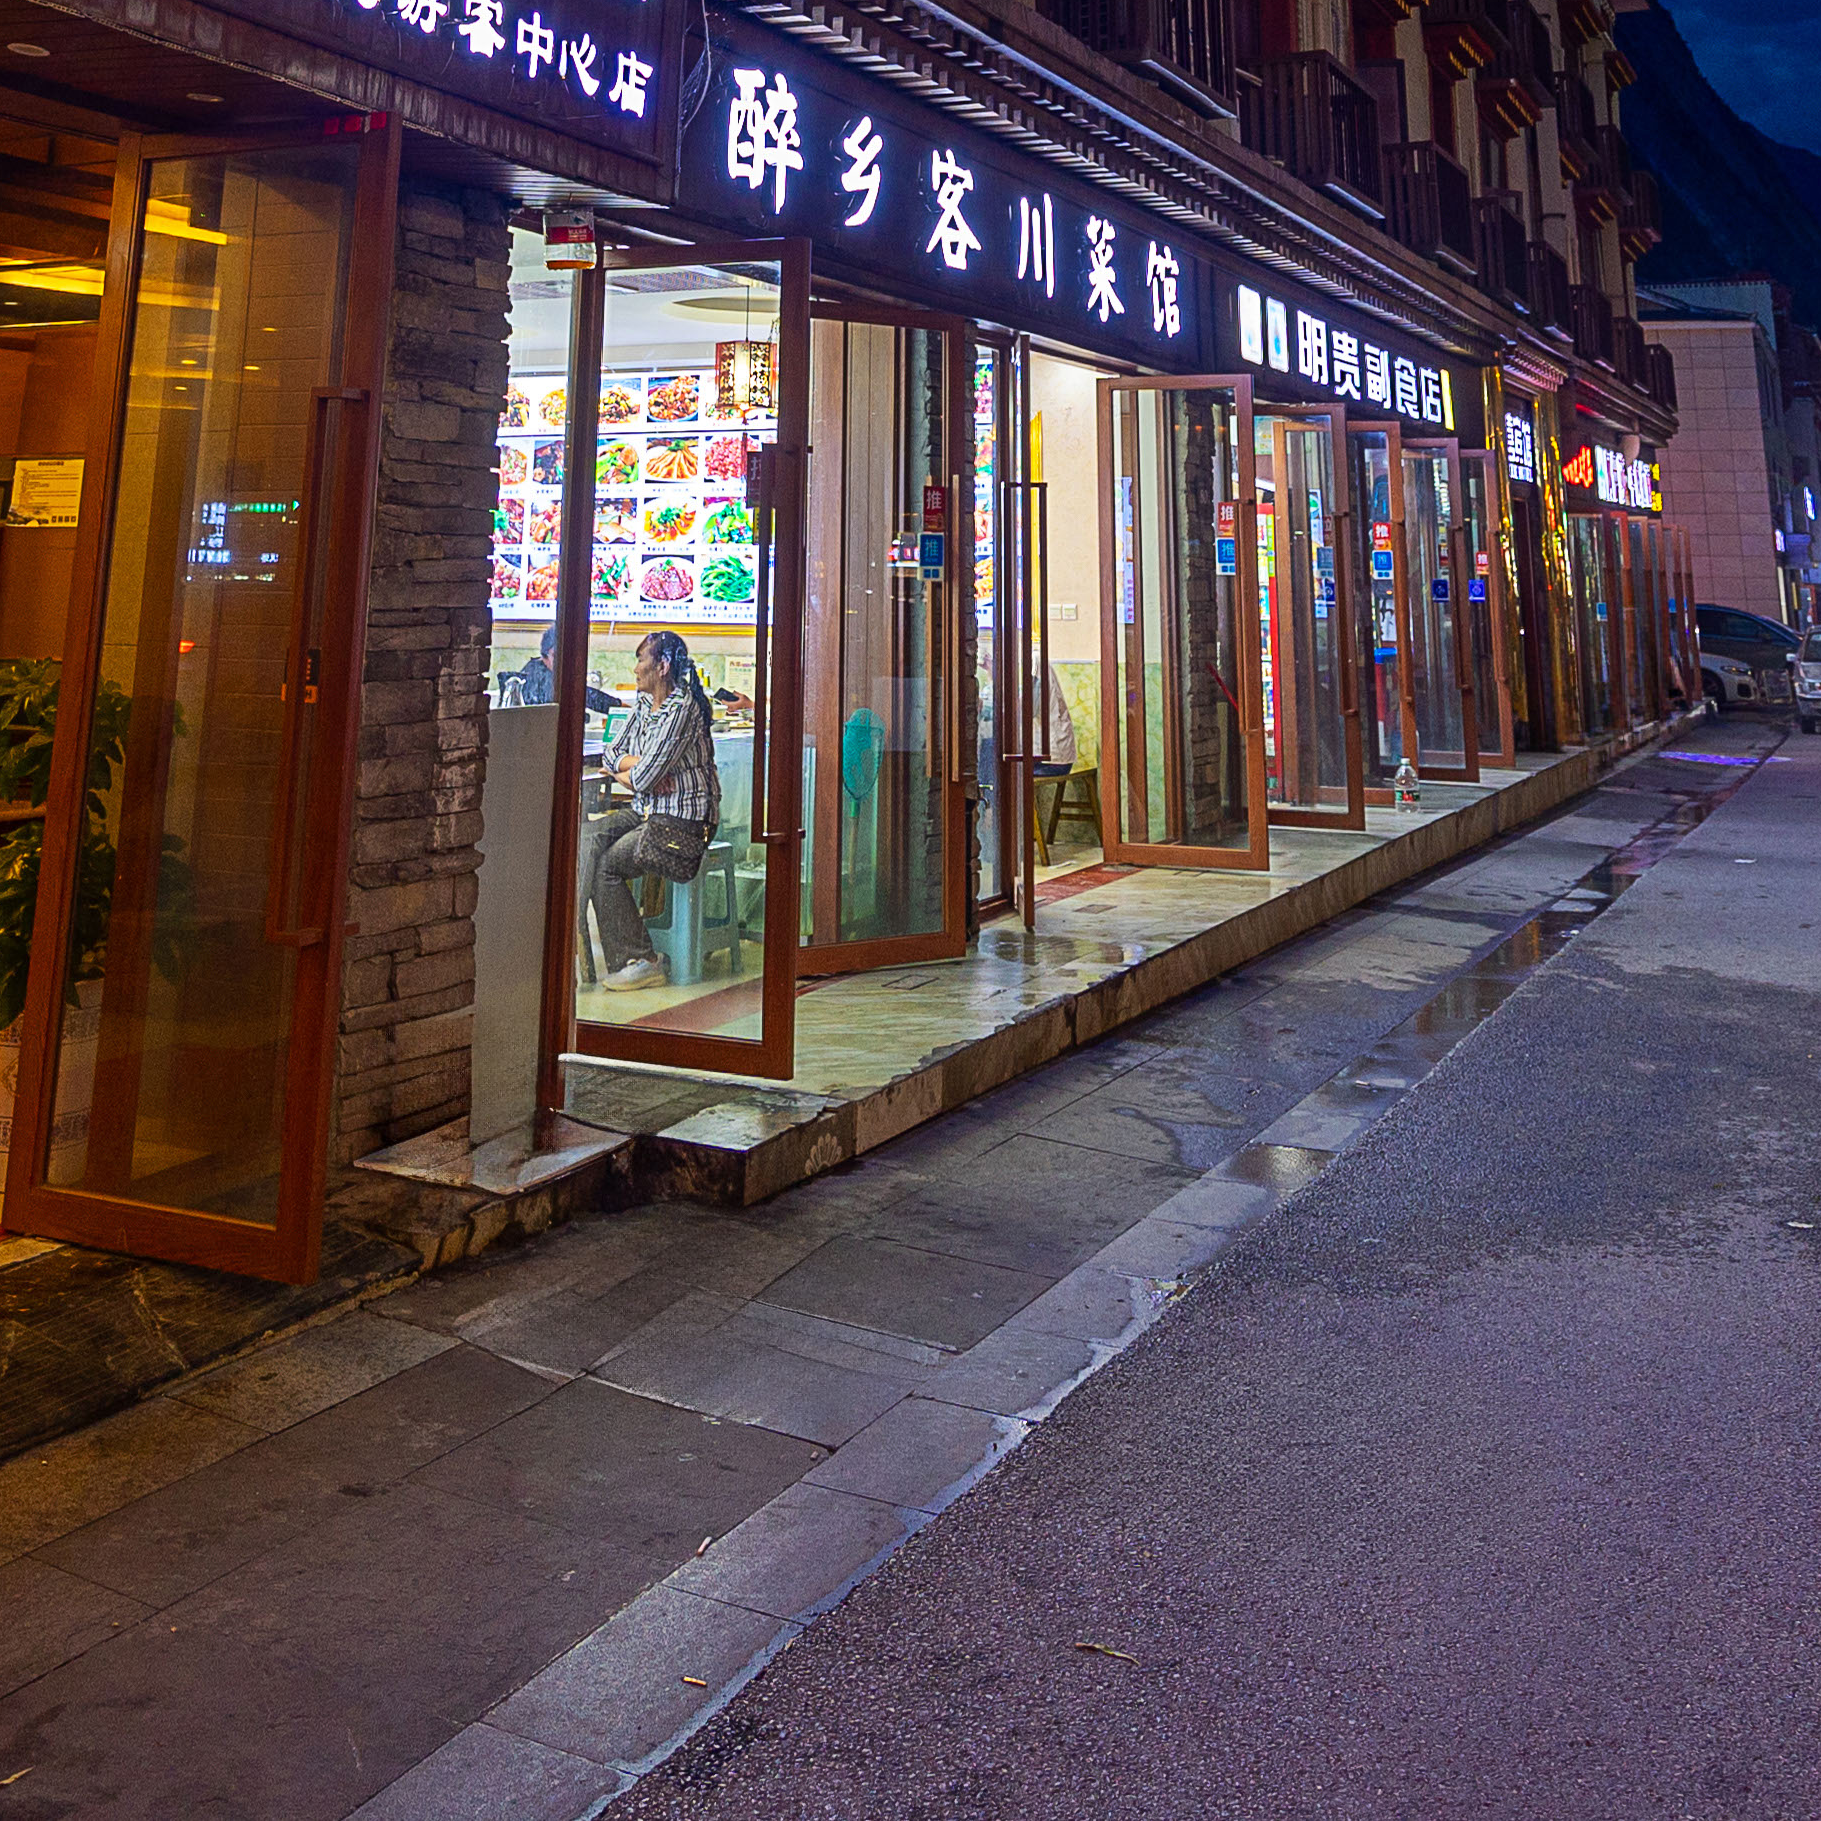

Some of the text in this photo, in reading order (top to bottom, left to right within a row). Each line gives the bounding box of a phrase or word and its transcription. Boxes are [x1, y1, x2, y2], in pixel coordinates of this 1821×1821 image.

[727, 67, 1182, 339] 醉乡客川菜馆
[1296, 309, 1443, 425] 明贵副食店
[926, 489, 942, 510] 推
